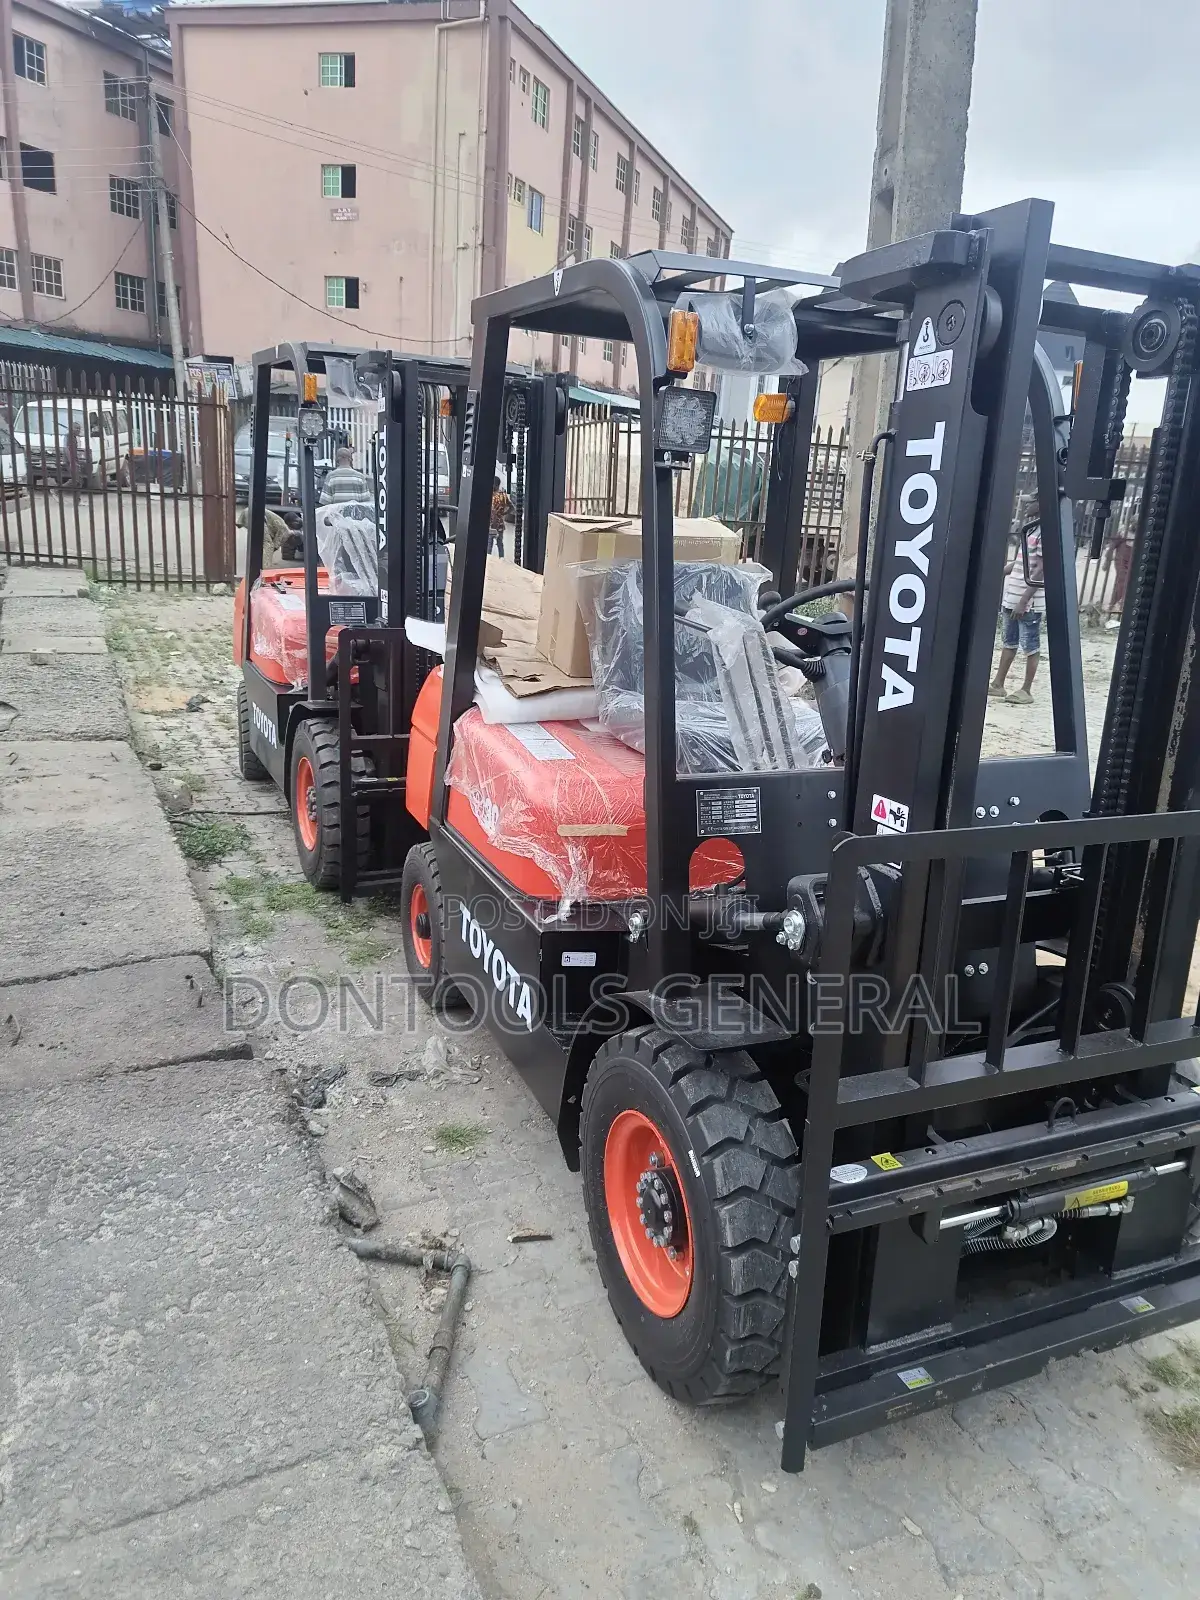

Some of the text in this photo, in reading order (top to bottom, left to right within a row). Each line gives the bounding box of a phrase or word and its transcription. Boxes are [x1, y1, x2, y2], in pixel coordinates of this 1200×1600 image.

[379, 425, 387, 550] TOYOTA
[877, 420, 946, 712] TOYOTA
[252, 701, 278, 750] TOYOTA
[458, 901, 533, 1033] TOYOTA
